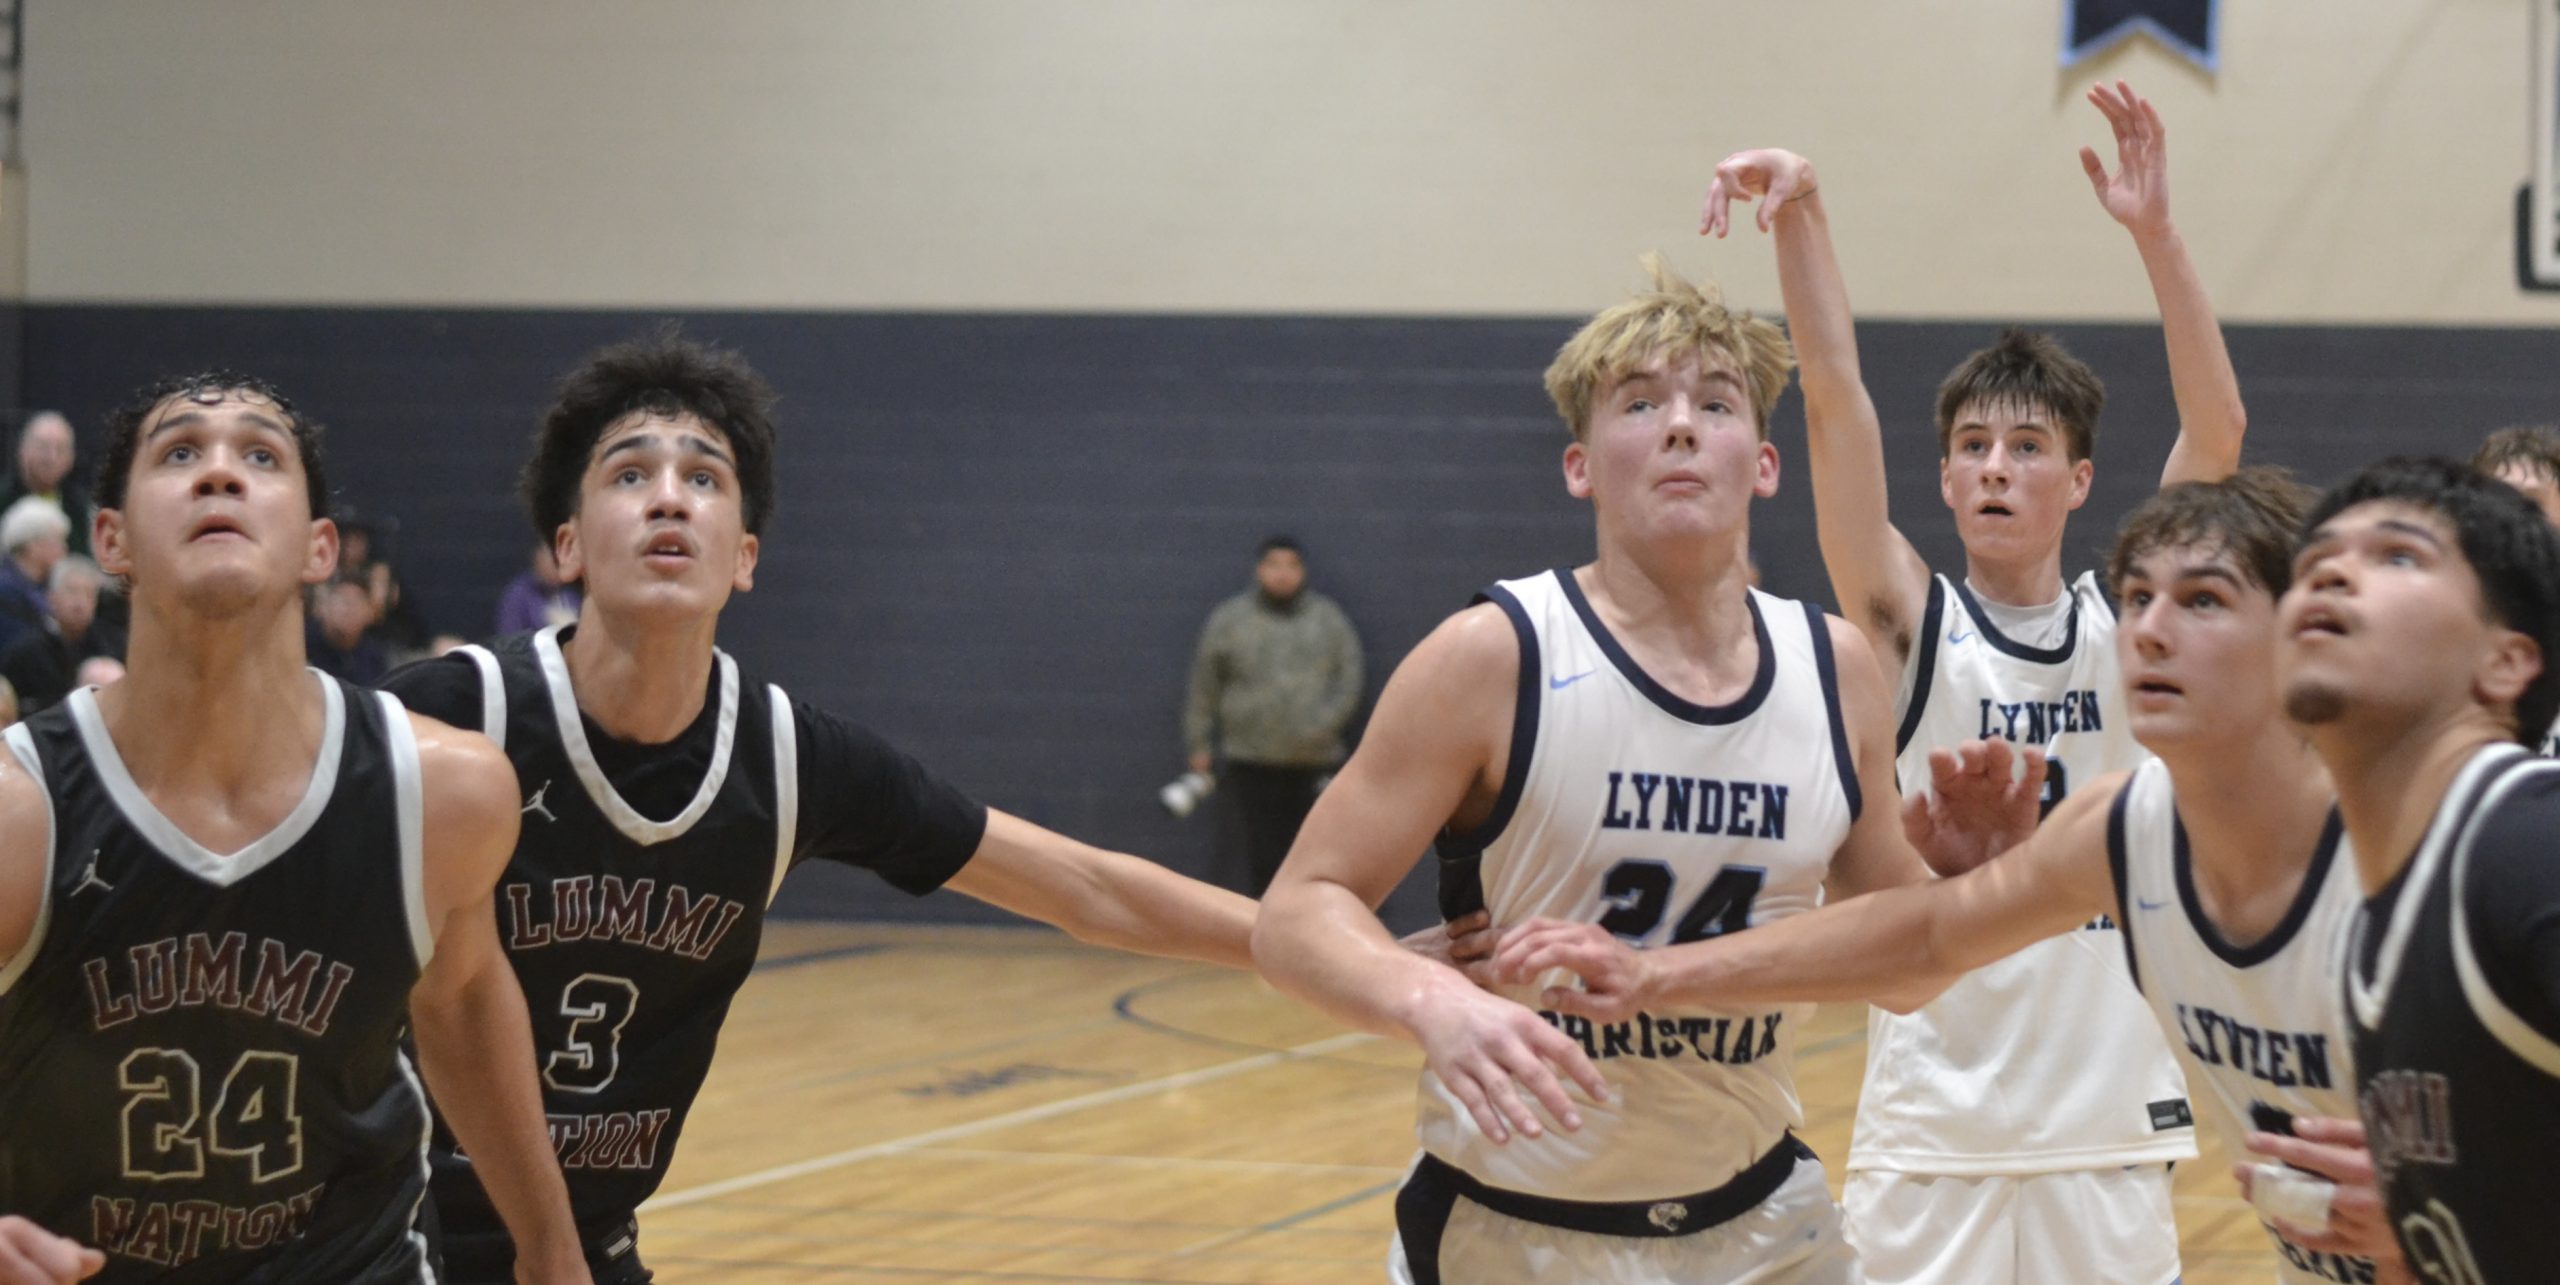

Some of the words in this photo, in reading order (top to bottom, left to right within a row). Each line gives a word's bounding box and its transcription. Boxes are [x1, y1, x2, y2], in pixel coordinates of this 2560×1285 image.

[1602, 772, 1789, 840] LYNDEN
[507, 875, 743, 960] LUMMI
[1598, 858, 1768, 948] 24
[84, 931, 354, 1036] LUMMI
[543, 973, 640, 1094] 3
[119, 1047, 303, 1183] 24
[546, 1108, 671, 1169] TION
